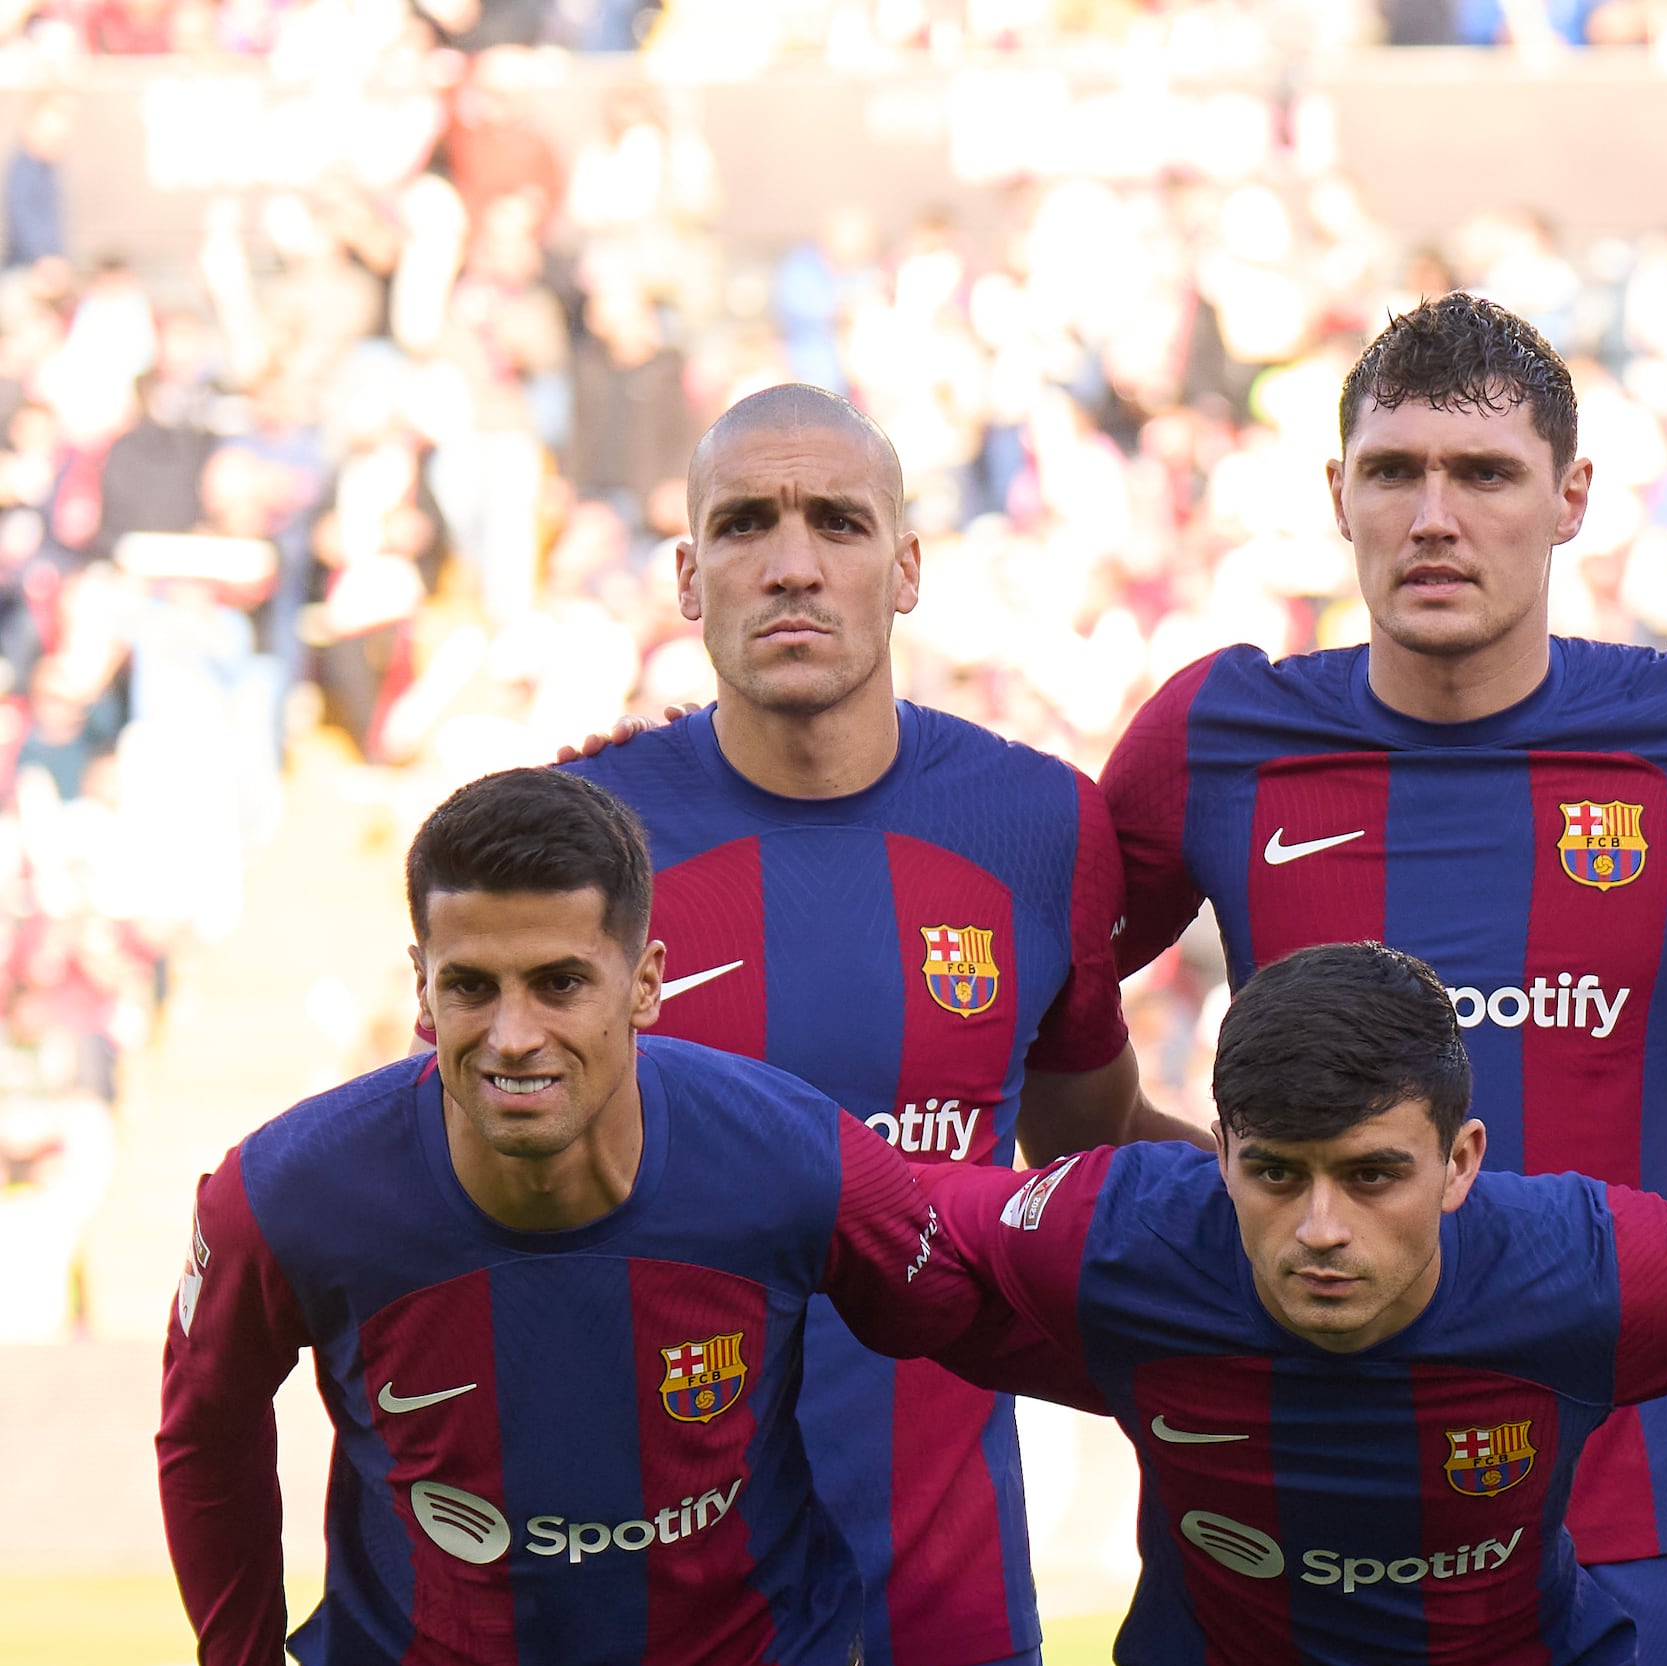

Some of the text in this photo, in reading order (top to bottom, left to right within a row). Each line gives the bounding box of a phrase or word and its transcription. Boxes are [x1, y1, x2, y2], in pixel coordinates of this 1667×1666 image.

[1586, 837, 1621, 848] FCB
[948, 963, 977, 974] FCB
[1446, 972, 1631, 1039] potify
[864, 1098, 980, 1161] otify
[688, 1370, 722, 1387] FCB
[1473, 1453, 1509, 1467] FCB
[526, 1478, 743, 1565] Spotify
[1300, 1527, 1524, 1594] Spotify
